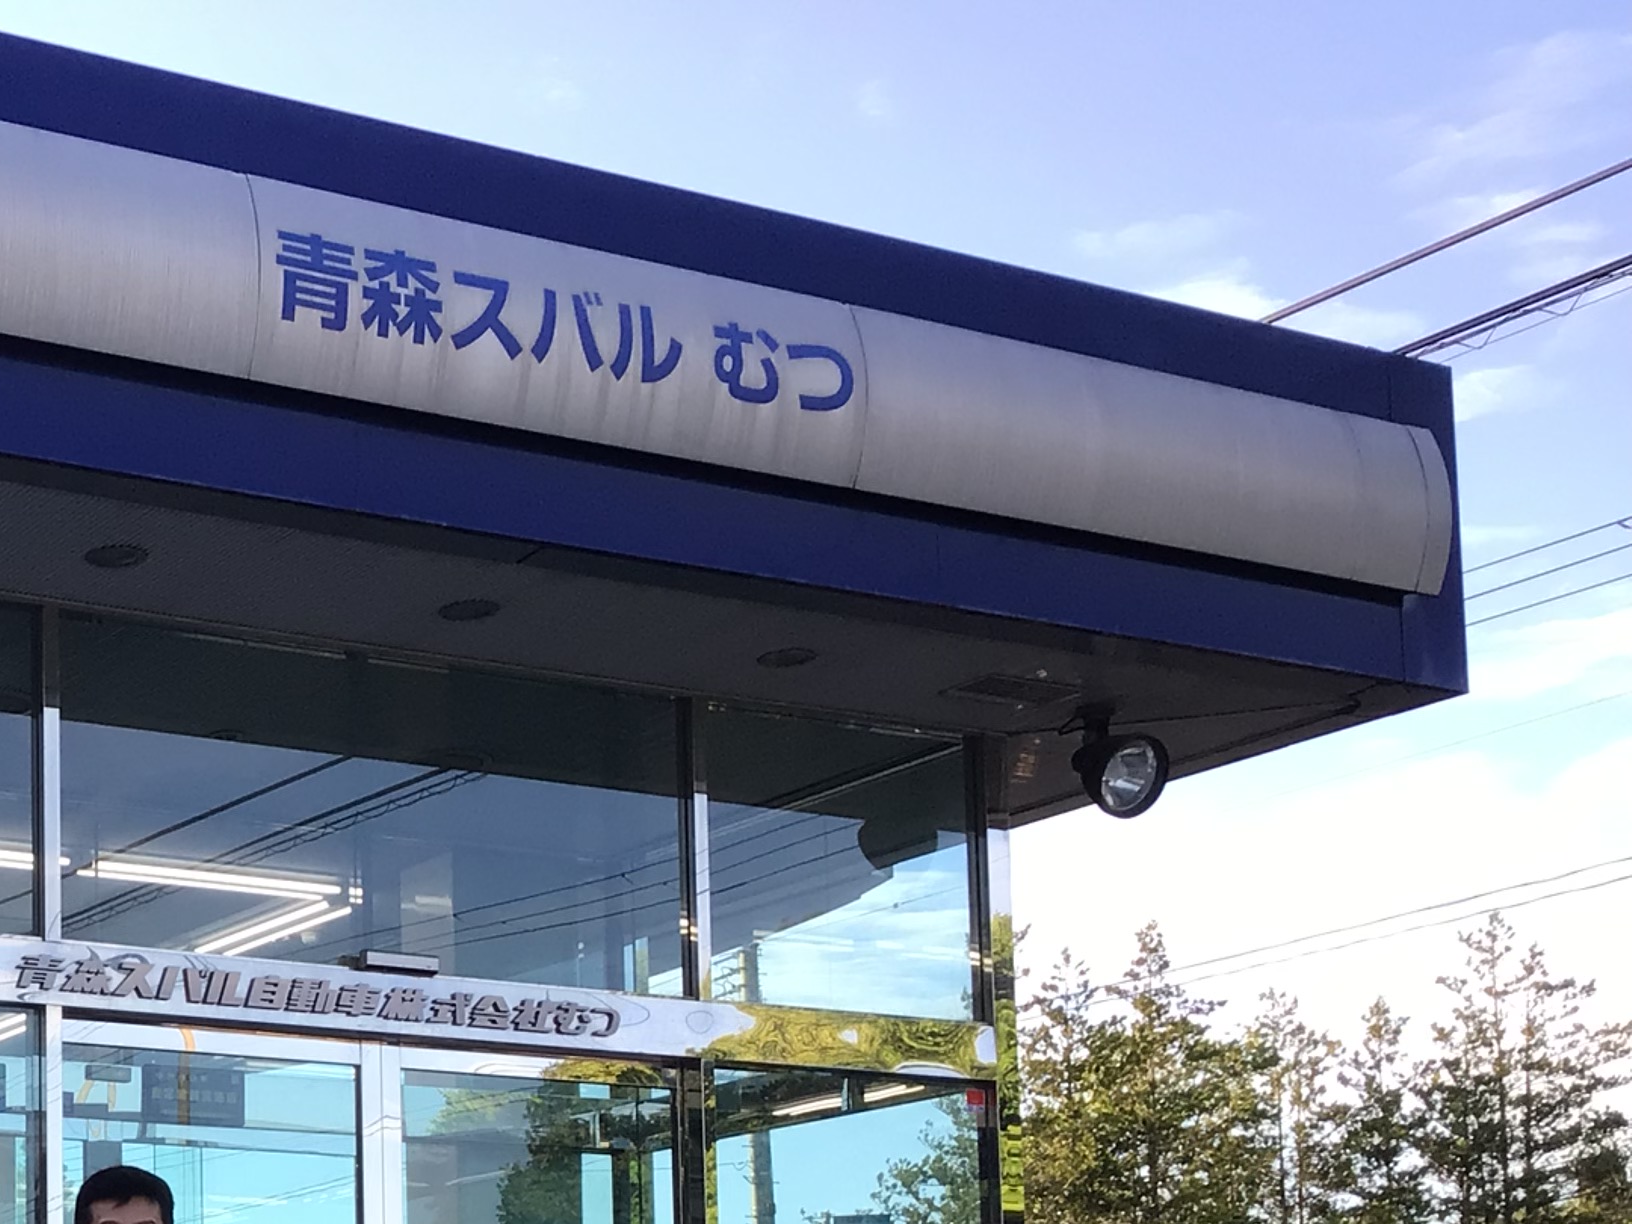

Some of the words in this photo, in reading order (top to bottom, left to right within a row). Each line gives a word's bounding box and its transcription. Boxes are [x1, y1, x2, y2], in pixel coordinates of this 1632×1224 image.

[275, 229, 683, 384] 青森スバル
[713, 321, 855, 412] むつ
[14, 954, 620, 1038] 青森スバル自動車株式会社むつ
